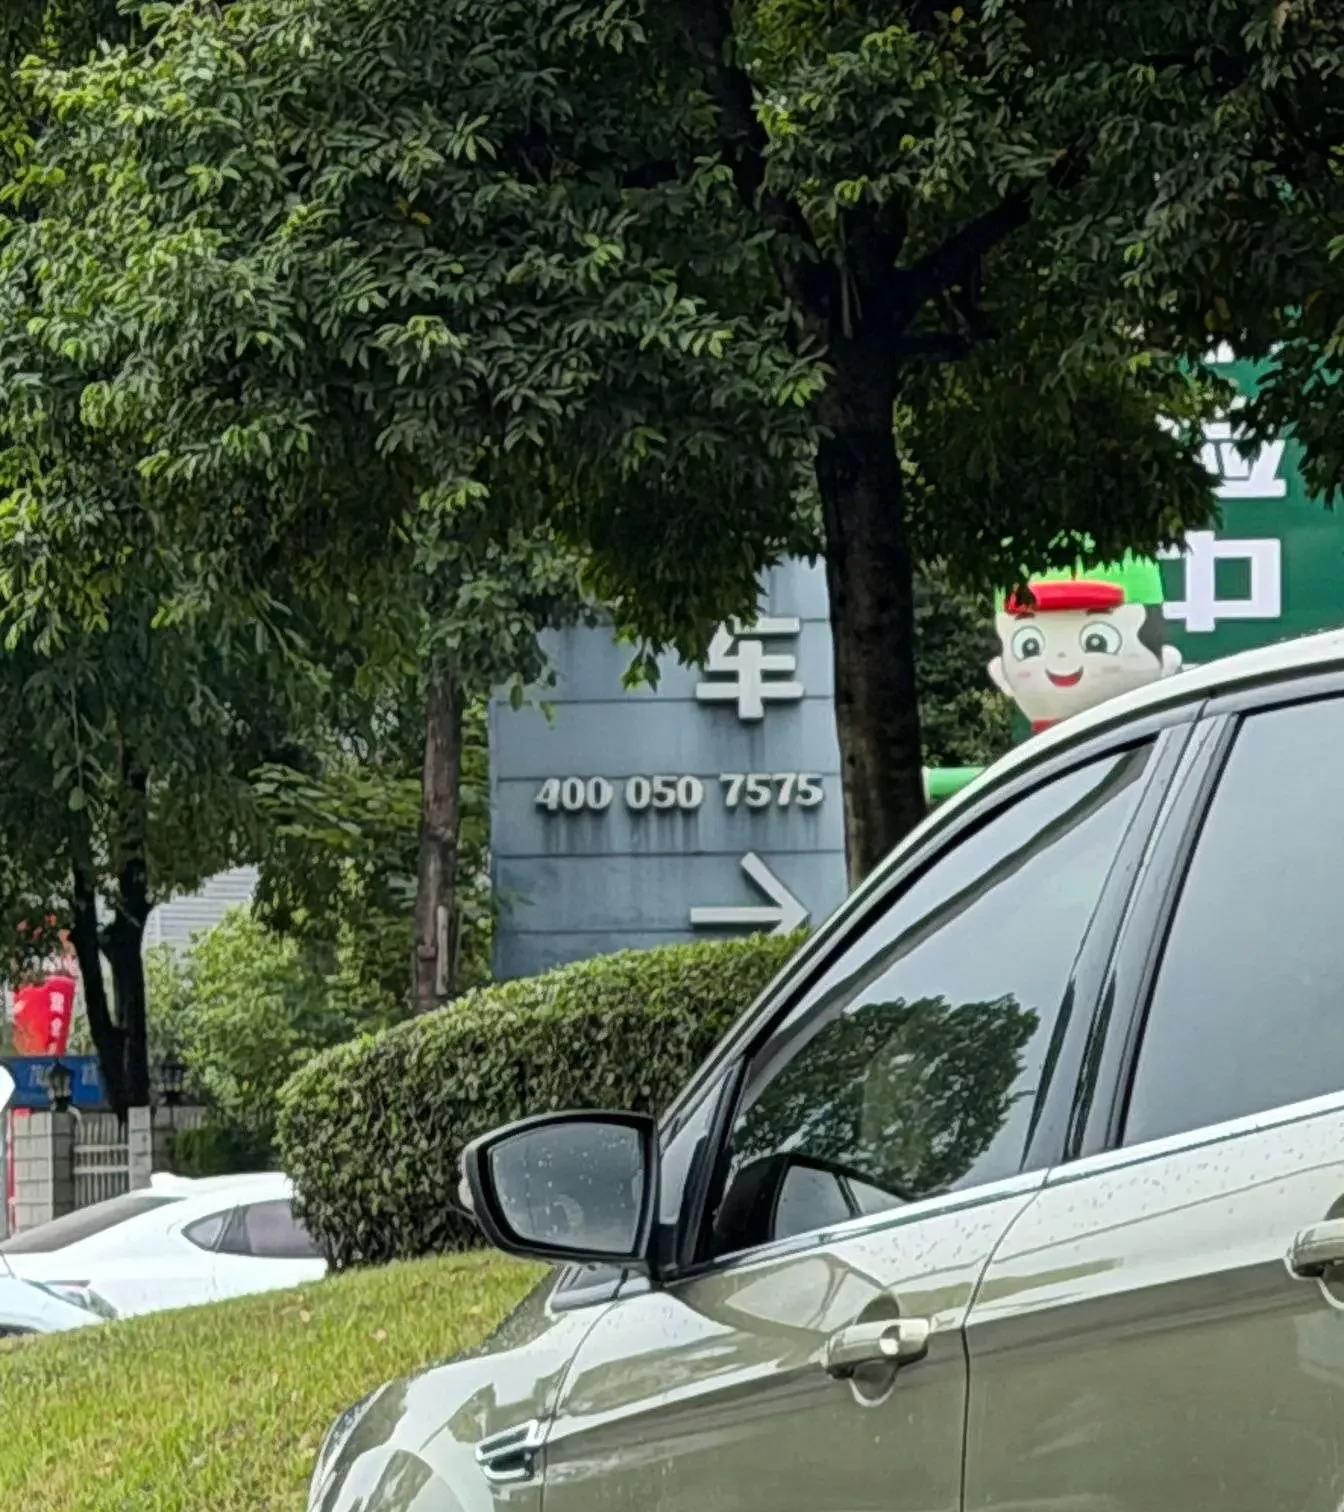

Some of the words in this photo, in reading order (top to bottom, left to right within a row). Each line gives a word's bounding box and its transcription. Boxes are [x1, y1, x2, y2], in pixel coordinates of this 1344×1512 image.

[696, 614, 804, 719] 车
[535, 777, 613, 810] 400
[625, 775, 703, 809] 050
[719, 773, 824, 806] 7575
